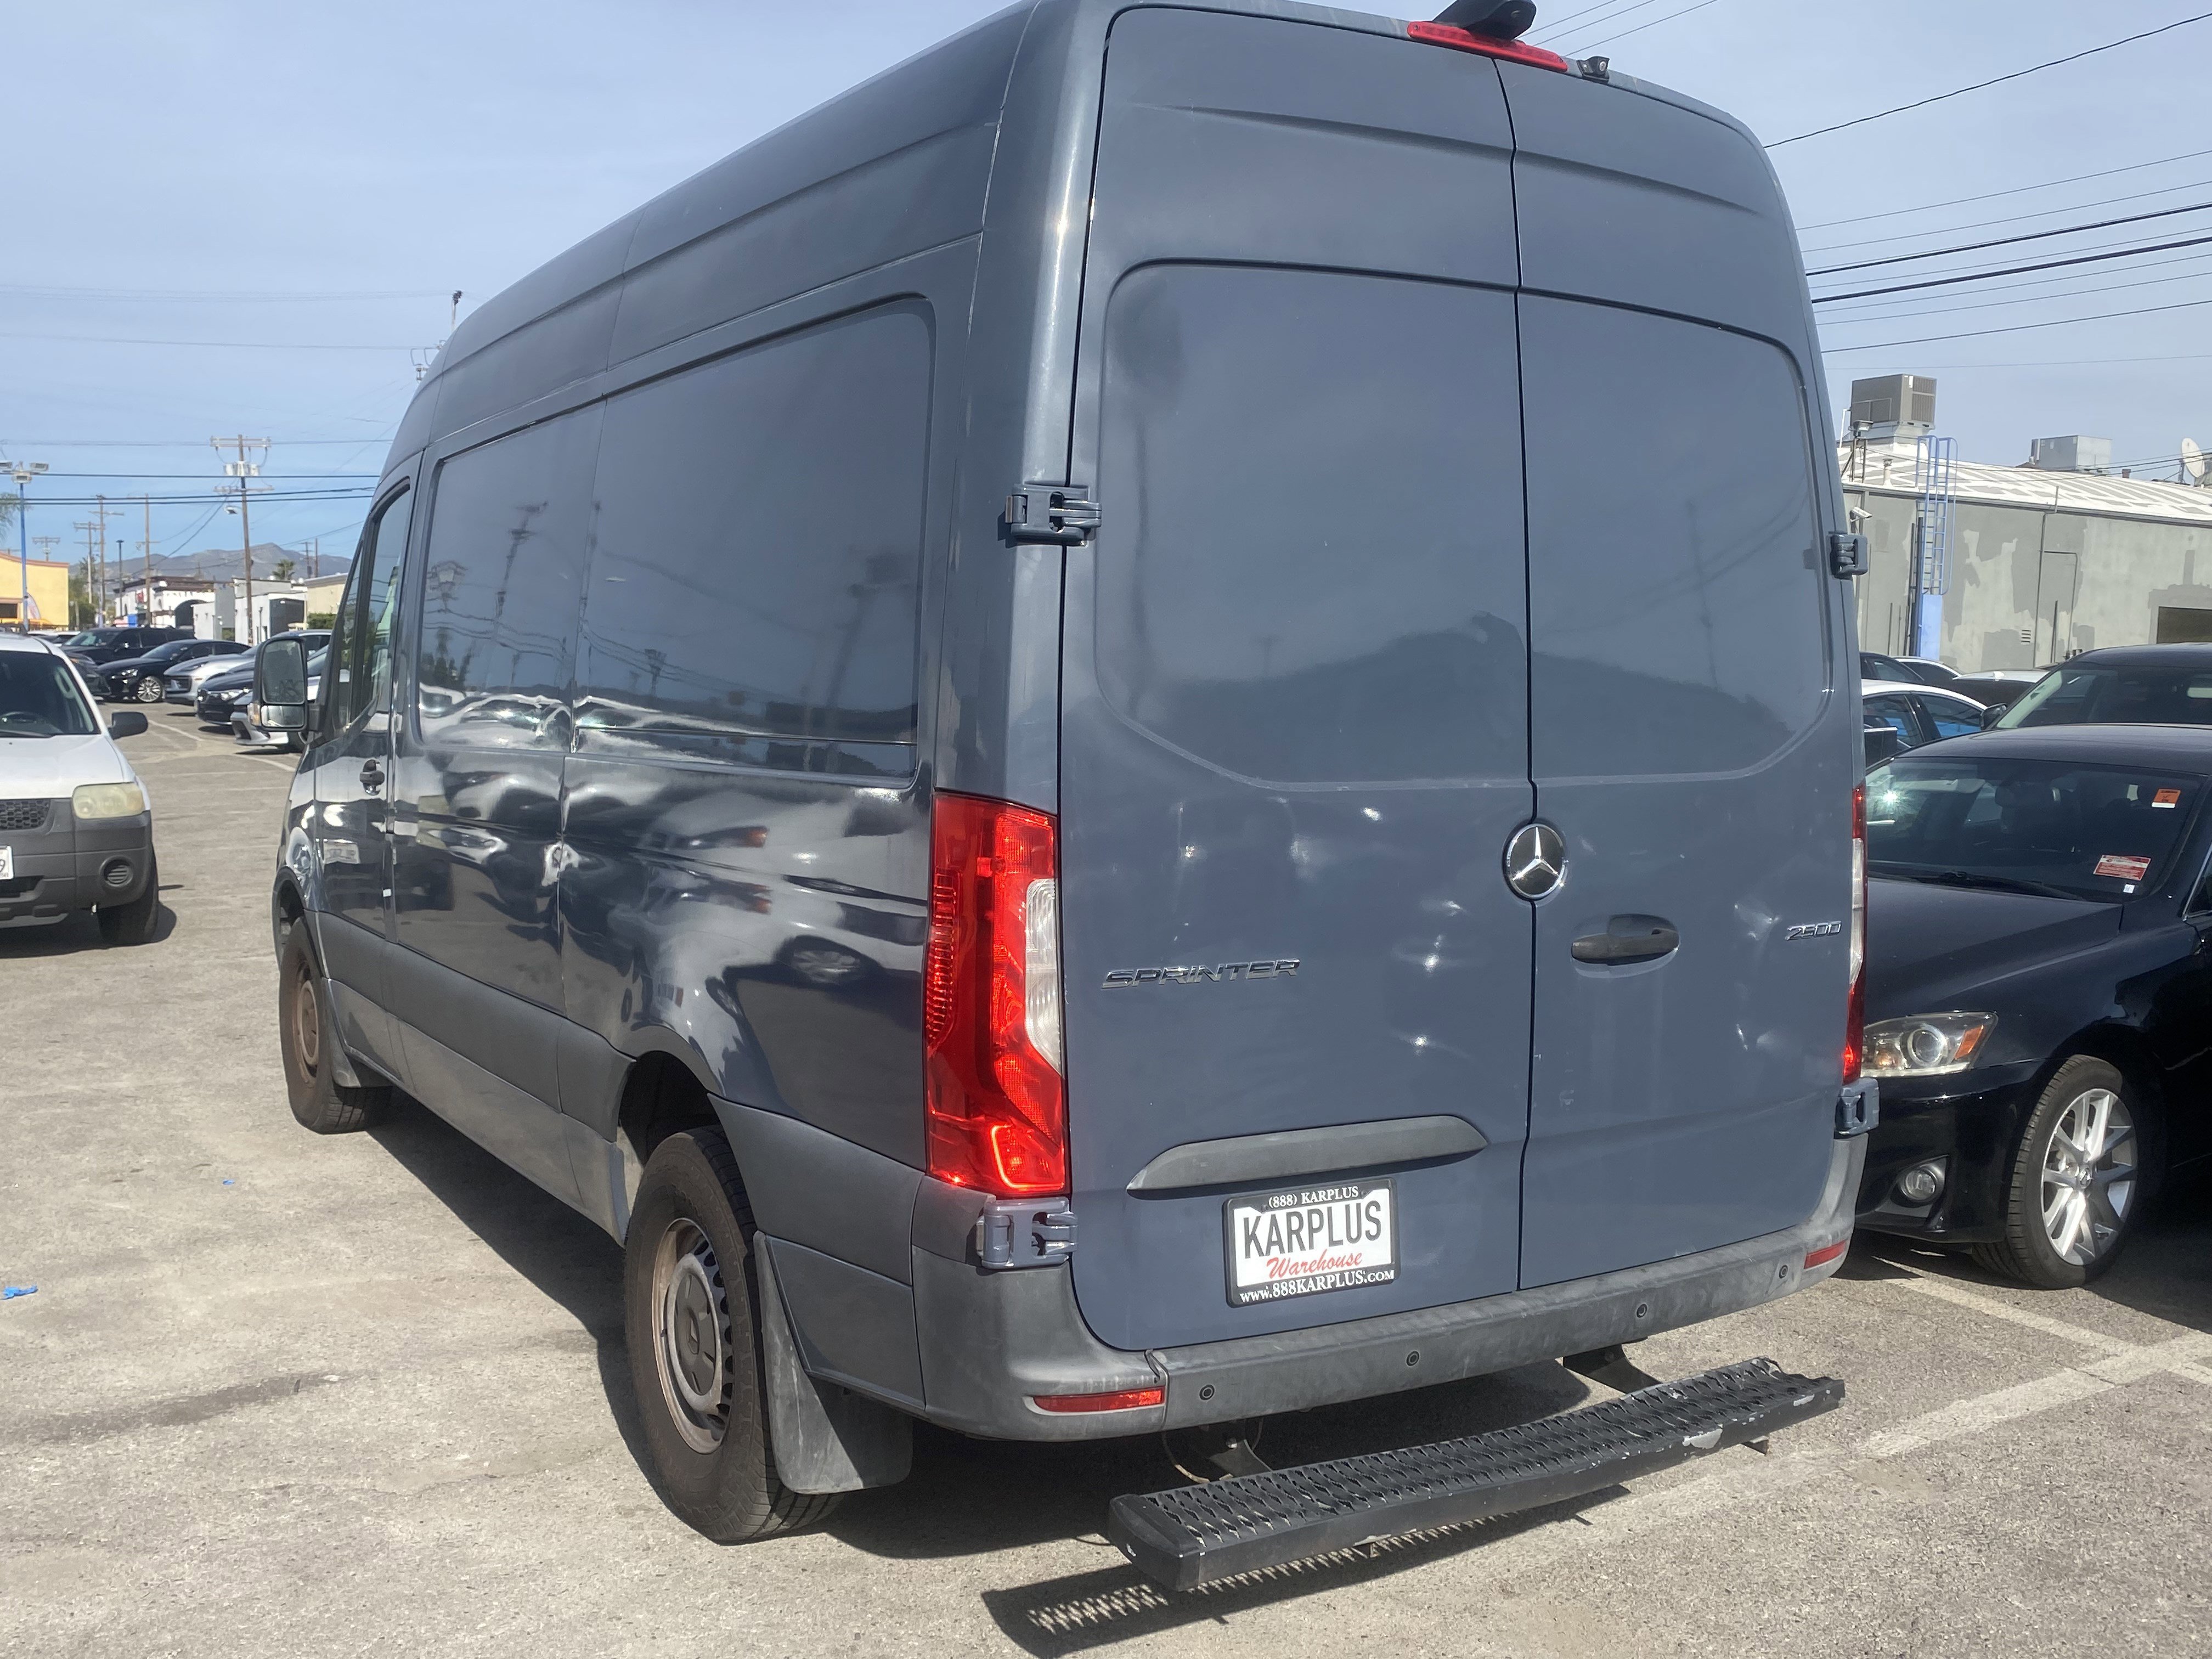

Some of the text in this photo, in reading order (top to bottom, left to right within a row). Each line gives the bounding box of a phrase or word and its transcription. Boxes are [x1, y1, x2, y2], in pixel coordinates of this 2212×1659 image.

[1785, 920, 1842, 941] 2500
[1101, 958, 1301, 990] SPRINTER
[1268, 1186, 1359, 1209] (888) KARPLUS
[1243, 1200, 1382, 1259] KARPLUS
[1266, 1249, 1363, 1279] Warehouse
